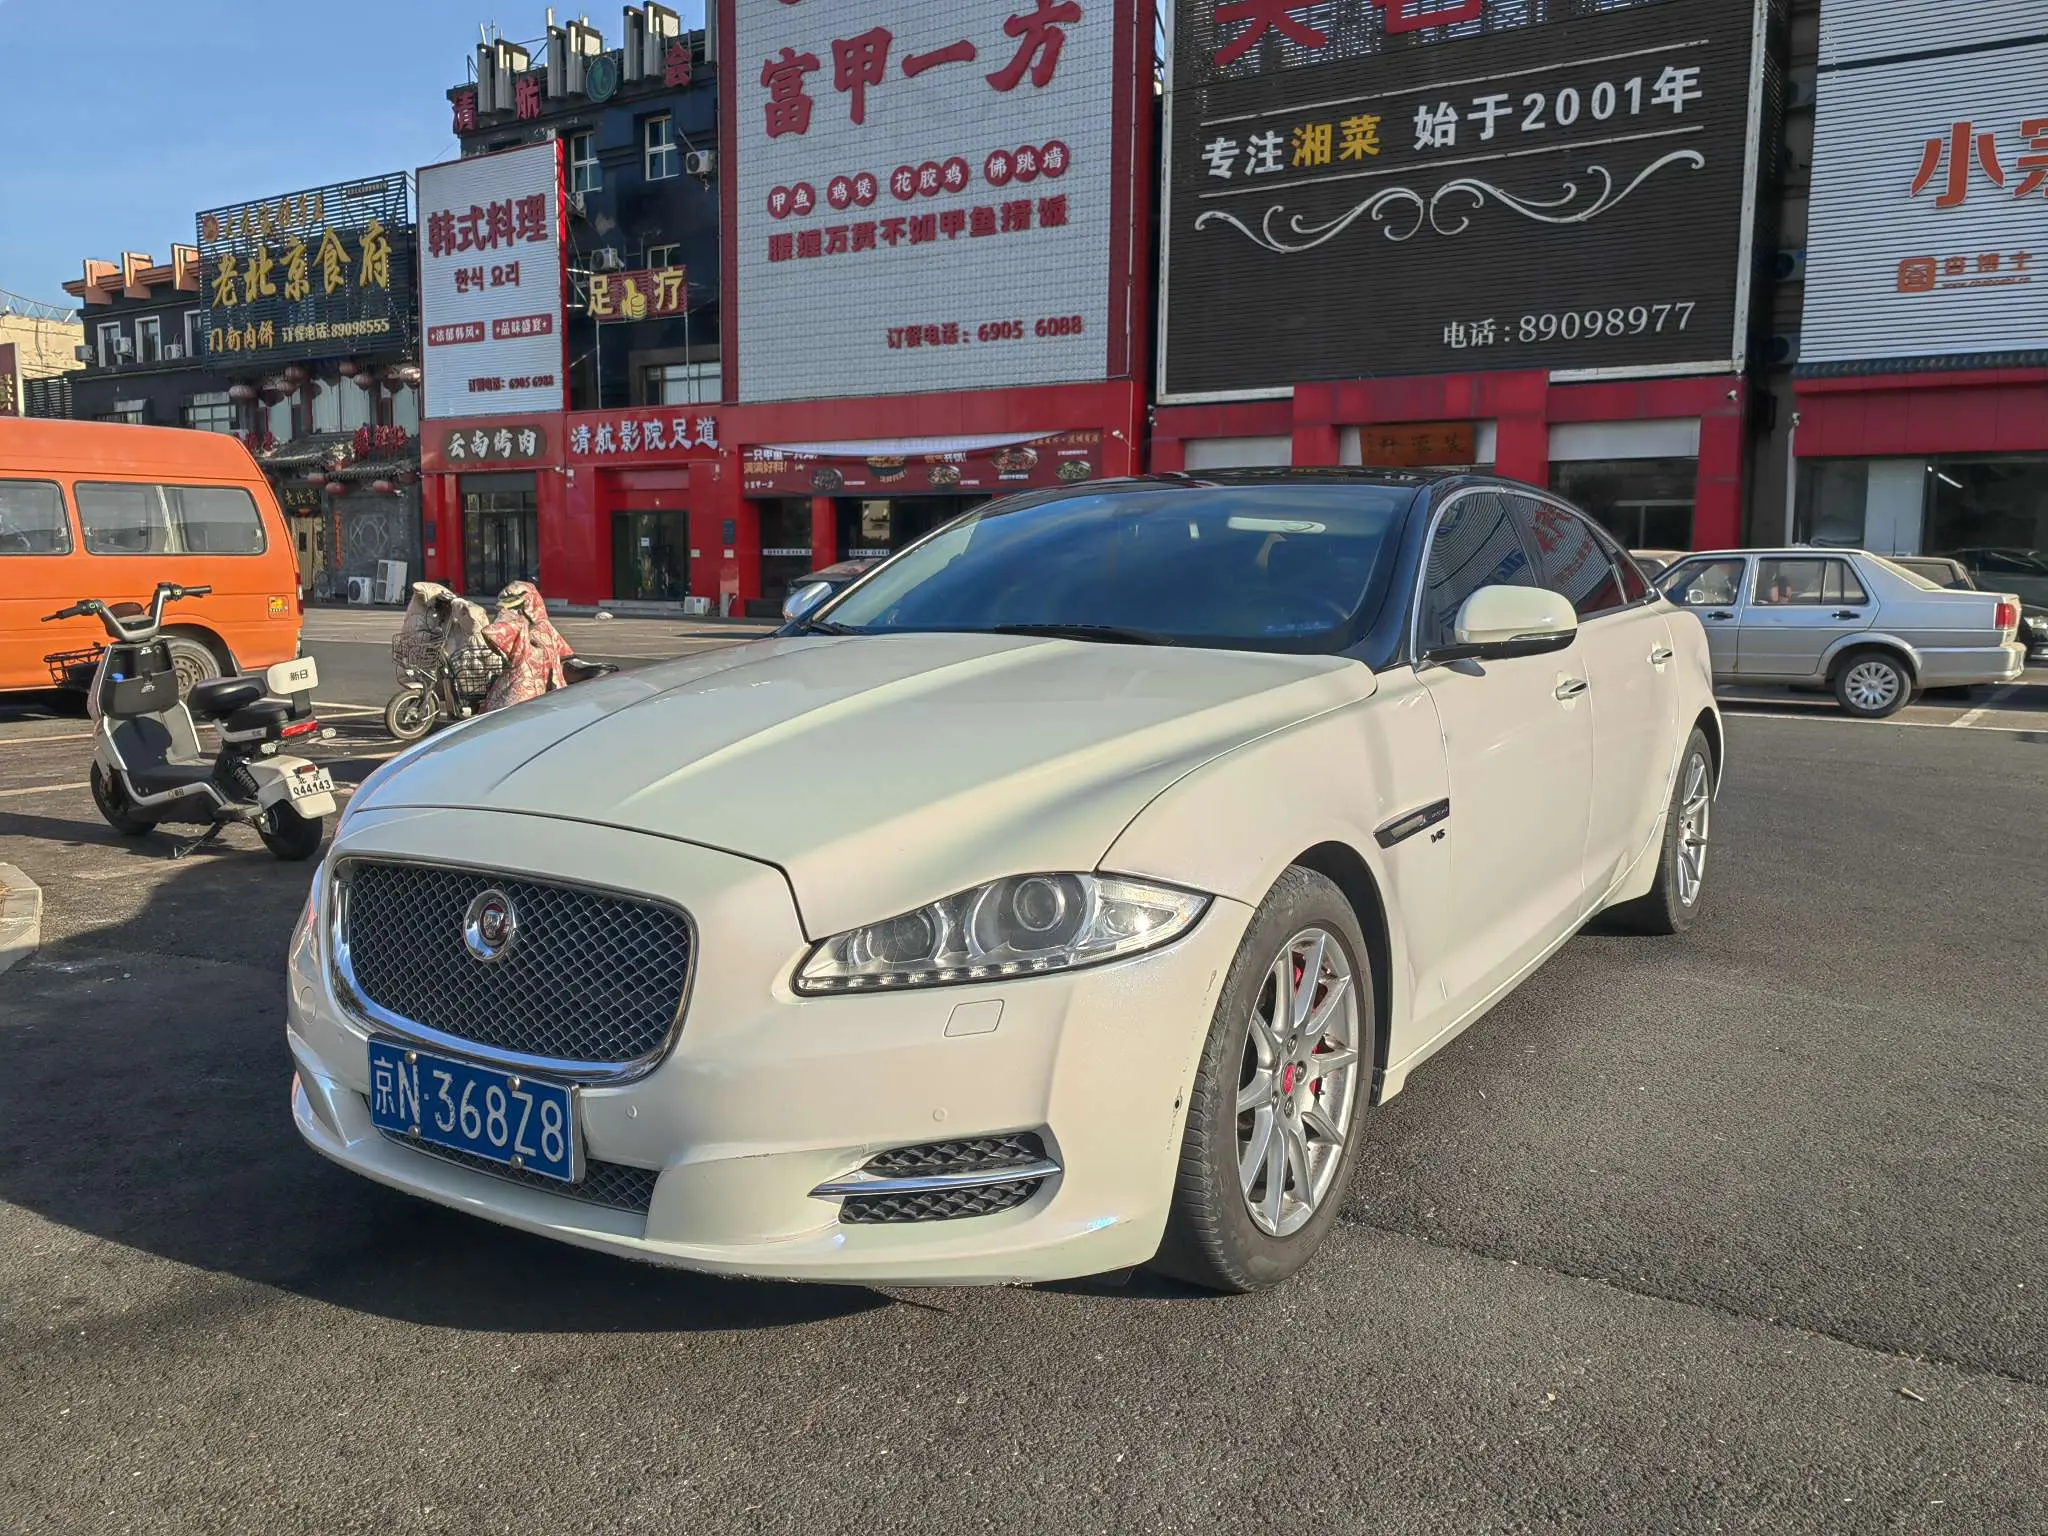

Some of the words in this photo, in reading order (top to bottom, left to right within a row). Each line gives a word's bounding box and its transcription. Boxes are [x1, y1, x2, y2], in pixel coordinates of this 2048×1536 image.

[760, 0, 1082, 138] 富甲一方
[1201, 114, 1382, 180] 专注湘菜
[1412, 66, 1704, 151] 始于2001年
[770, 186, 813, 215] 甲鱼
[829, 176, 874, 205] 鸡煲
[893, 163, 964, 195] 花胶鸡
[985, 143, 1066, 181] 佛跳墙
[427, 193, 548, 258] 韩式料理
[211, 219, 392, 308] 老北京食府
[454, 265, 485, 293] 한식
[490, 261, 521, 288] 요리
[1034, 315, 1084, 338] 6088
[570, 416, 719, 455] 清航影院足道
[293, 779, 331, 796] Q44143
